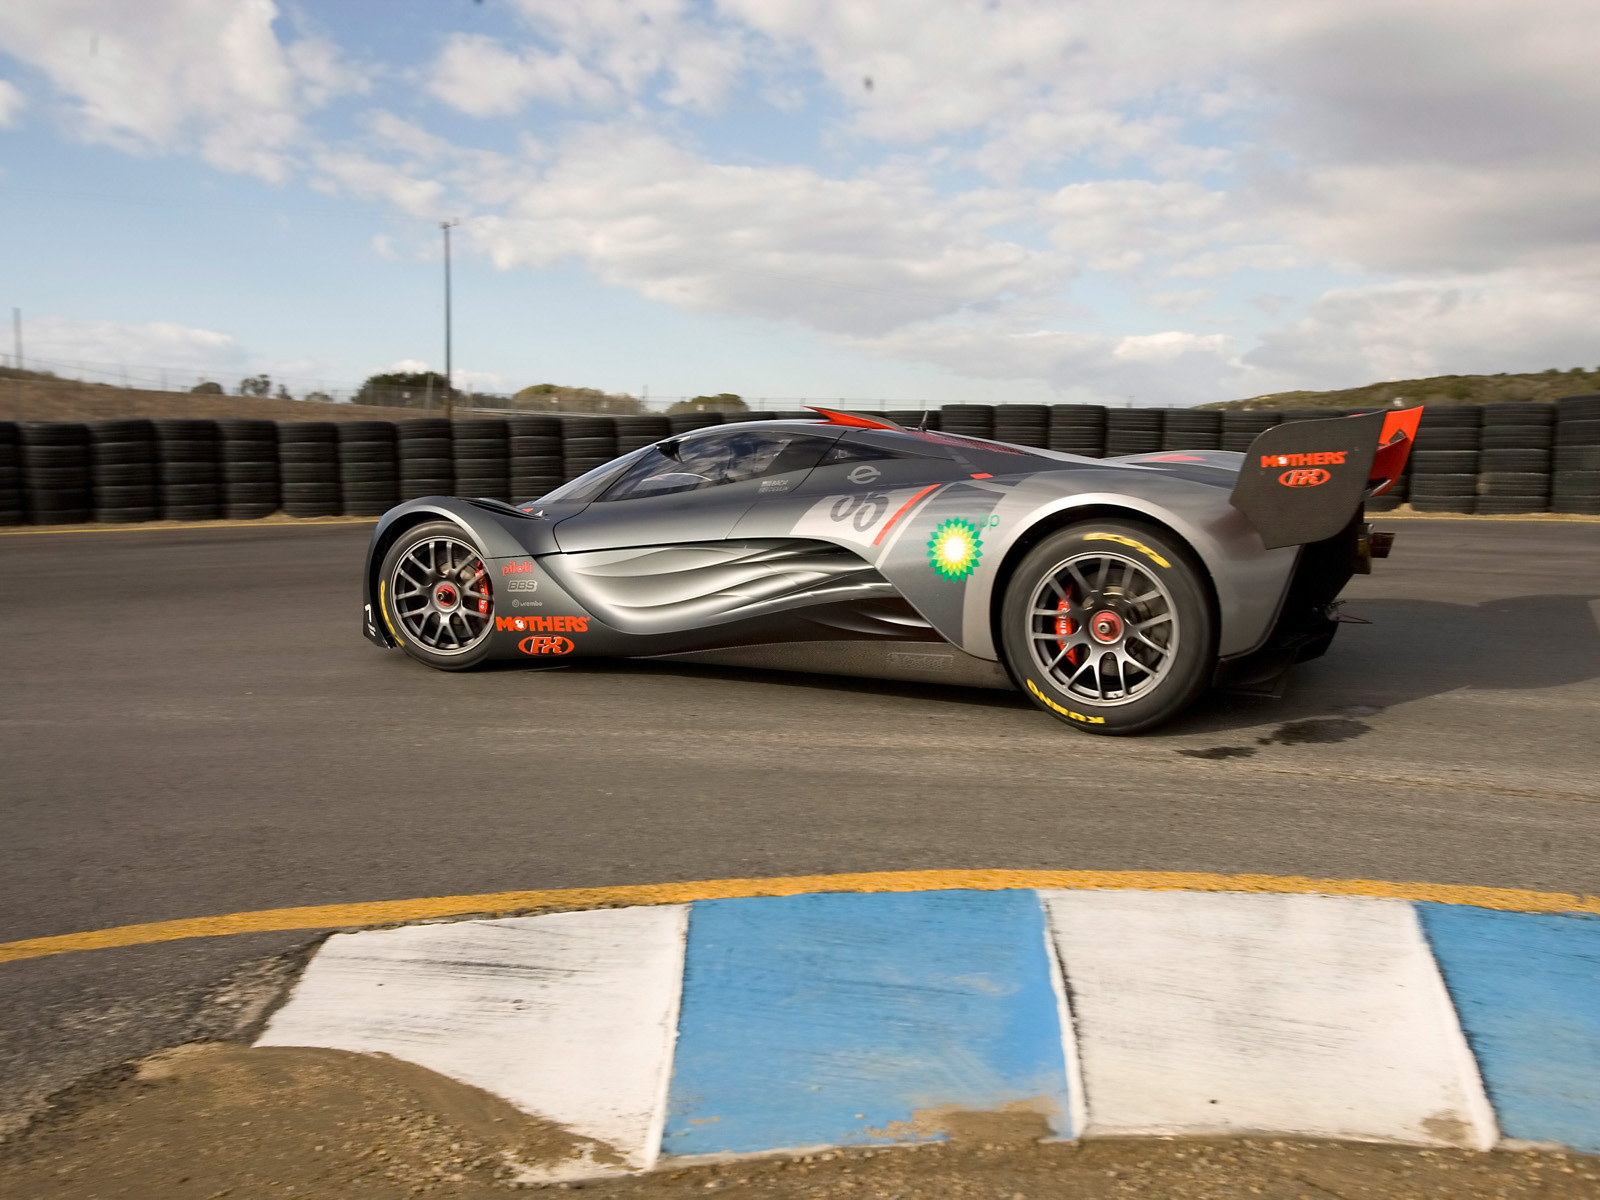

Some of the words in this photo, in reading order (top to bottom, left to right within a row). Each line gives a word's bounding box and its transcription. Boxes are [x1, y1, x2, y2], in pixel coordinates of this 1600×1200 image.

[979, 511, 1000, 532] bp
[501, 560, 533, 577] piloti
[507, 580, 537, 592] BBS
[495, 615, 589, 633] MOTHERS
